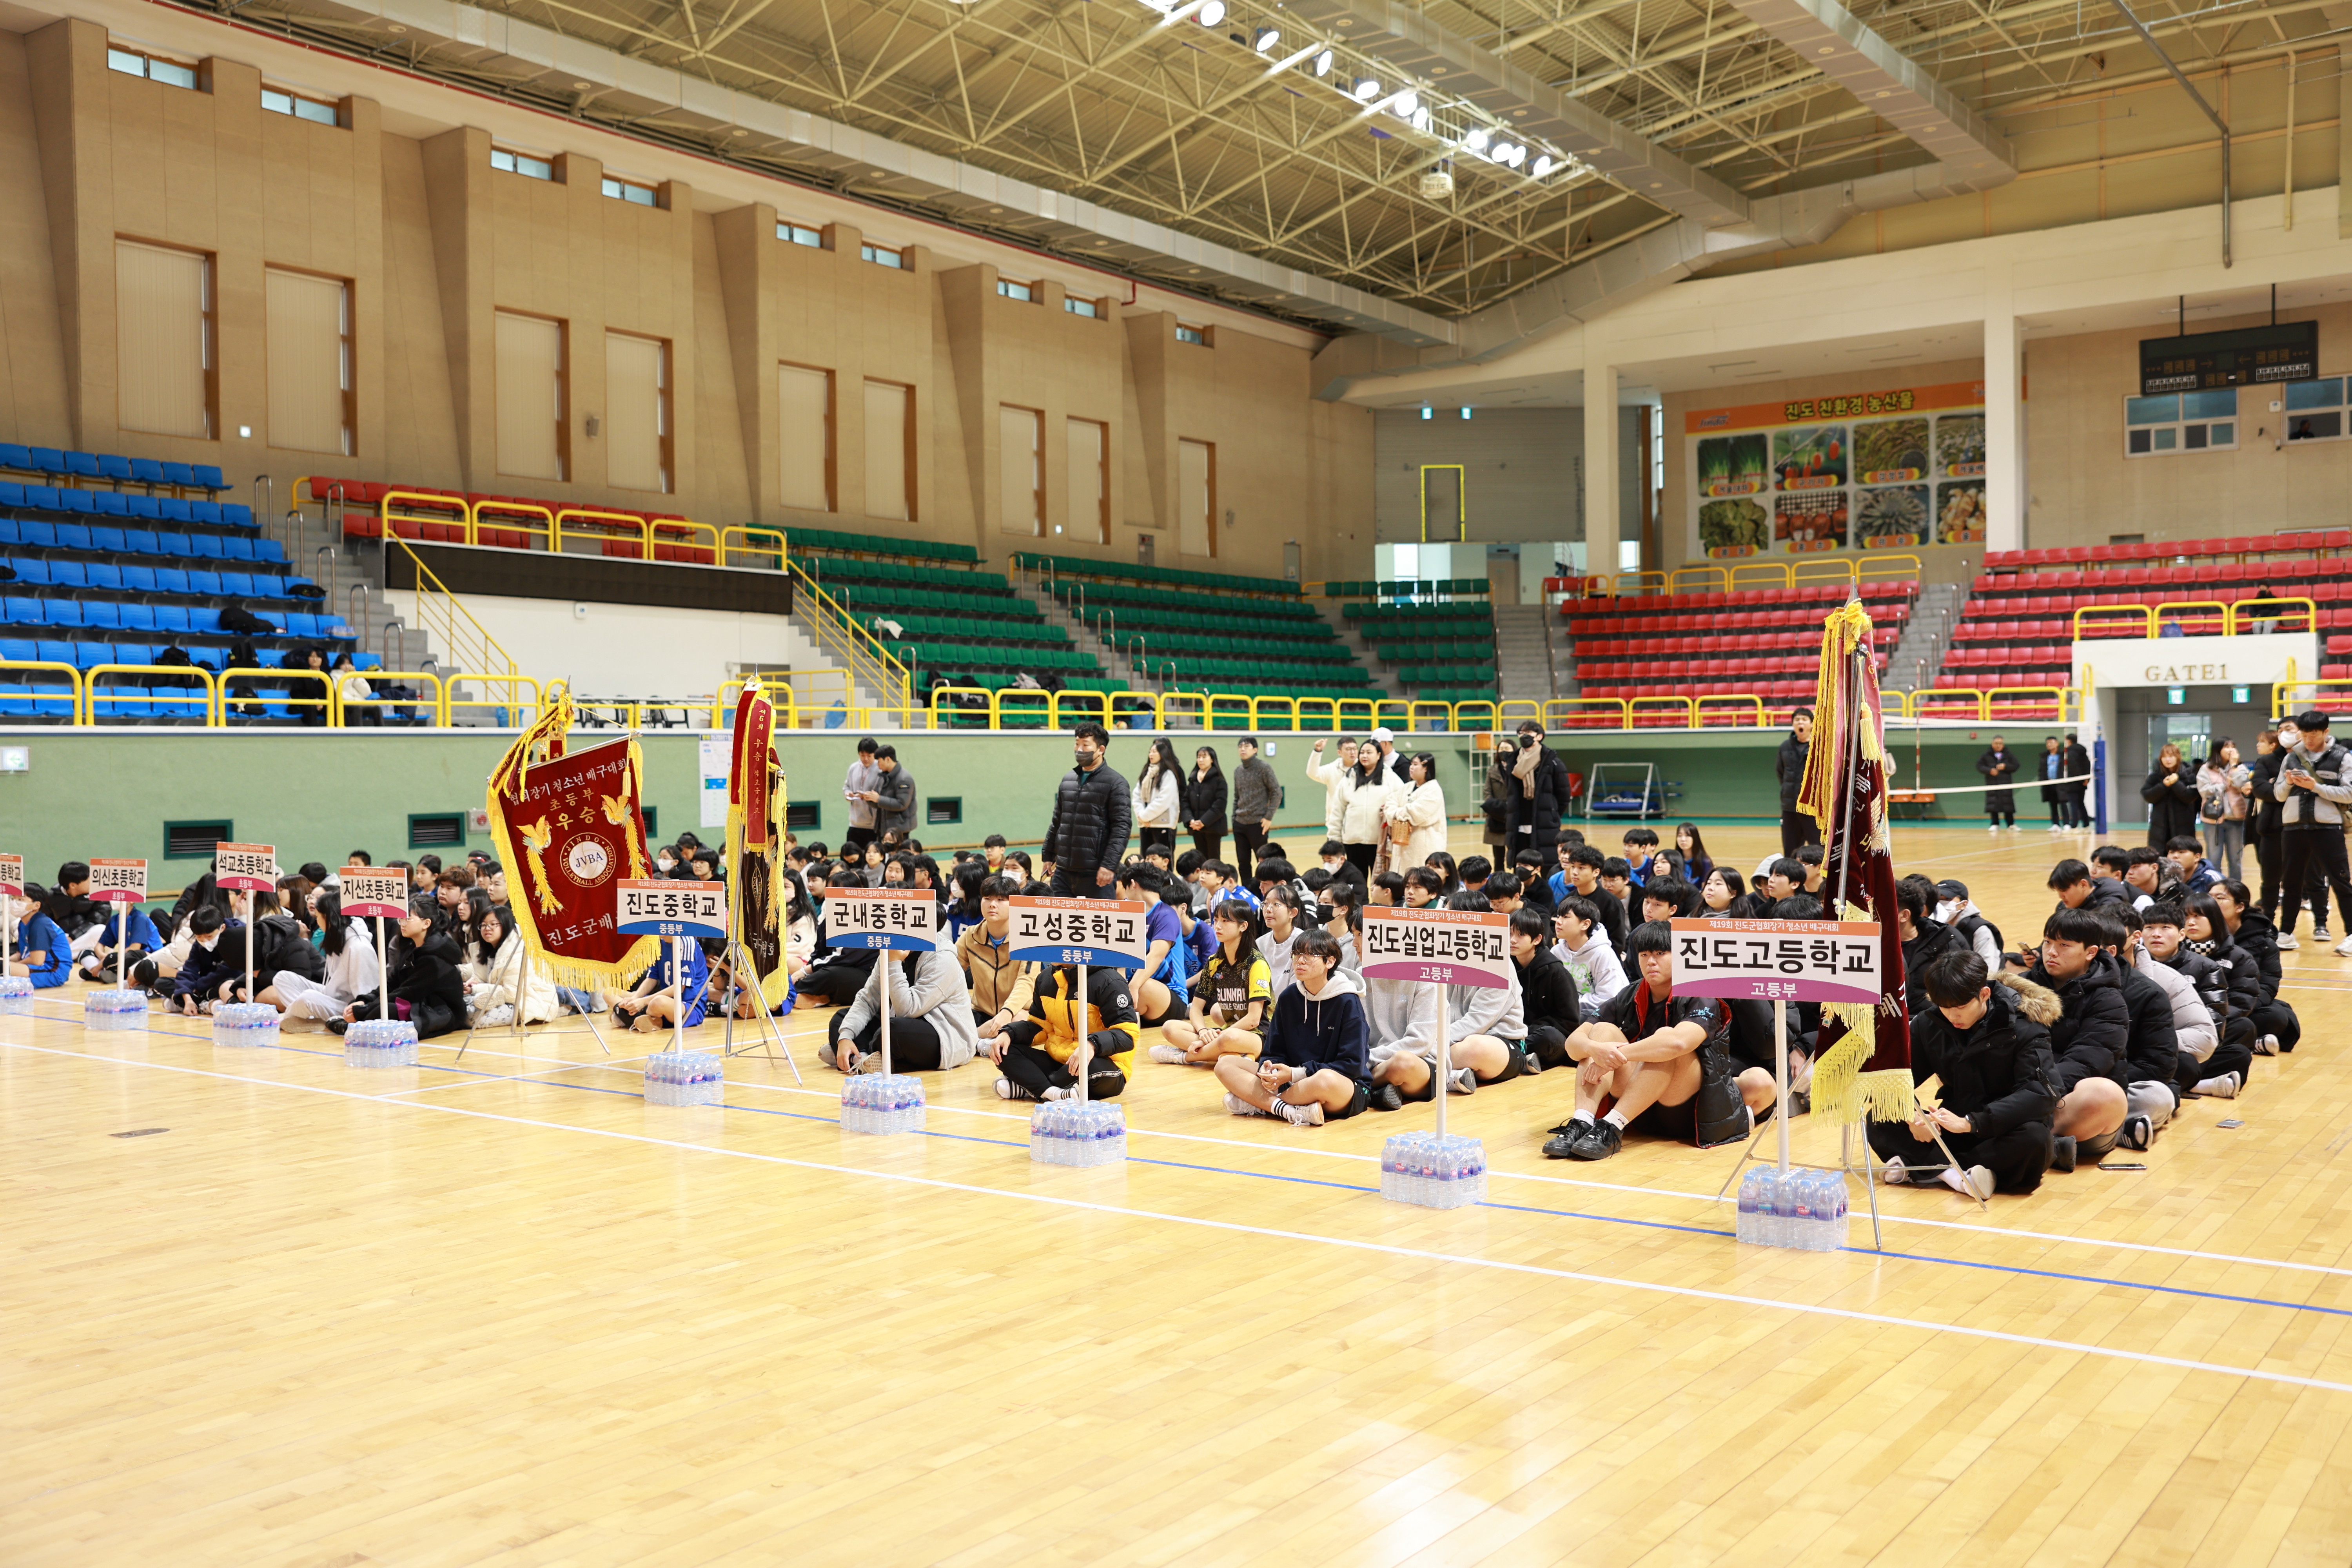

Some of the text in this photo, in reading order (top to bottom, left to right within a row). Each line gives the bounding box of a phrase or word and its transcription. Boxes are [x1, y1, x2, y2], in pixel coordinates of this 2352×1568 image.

[1785, 390, 1914, 421] 진도 친환경 농산물
[2145, 664, 2227, 681] GATE1
[757, 709, 766, 730] 제6회
[753, 738, 763, 762] 우승
[553, 772, 585, 792] 청소년
[586, 758, 627, 781] 배구대회
[550, 788, 594, 811] 초등부
[556, 806, 596, 831] 우승
[566, 835, 599, 851] JINDO
[219, 854, 272, 876] 석교초등학교
[563, 845, 614, 886] VOLLEYBALL ASSOCIATION
[575, 852, 603, 867] JVBA
[0, 864, 21, 882] 등학교
[92, 868, 144, 888] 의신초등학교
[238, 879, 253, 888] 초등부
[344, 879, 405, 901] 지산초등학교
[112, 892, 125, 900] 초등부
[627, 893, 717, 918] 진도중학교
[1051, 899, 1084, 908] 진도군협회장기
[1085, 900, 1099, 909] 청소년
[1100, 901, 1119, 909] 배구대회
[368, 906, 382, 915] 초등부
[834, 903, 927, 929] 군내중학교
[1390, 909, 1481, 922] 제19회 진도군협회장기 청소년 배구대회
[547, 913, 617, 946] 진도군배
[659, 923, 683, 934] 중등부
[1019, 913, 1135, 944] 고성중학교
[1709, 920, 1839, 932] 제19회 진도군협회장기 청소년 배구대회
[867, 936, 891, 948] 중등부
[1368, 924, 1504, 962] 진도실업고등학교
[1062, 949, 1093, 963] 중등부
[1679, 937, 1874, 975] 진도고등학교
[1419, 967, 1453, 982] 고등부
[1751, 982, 1797, 998] 고등부
